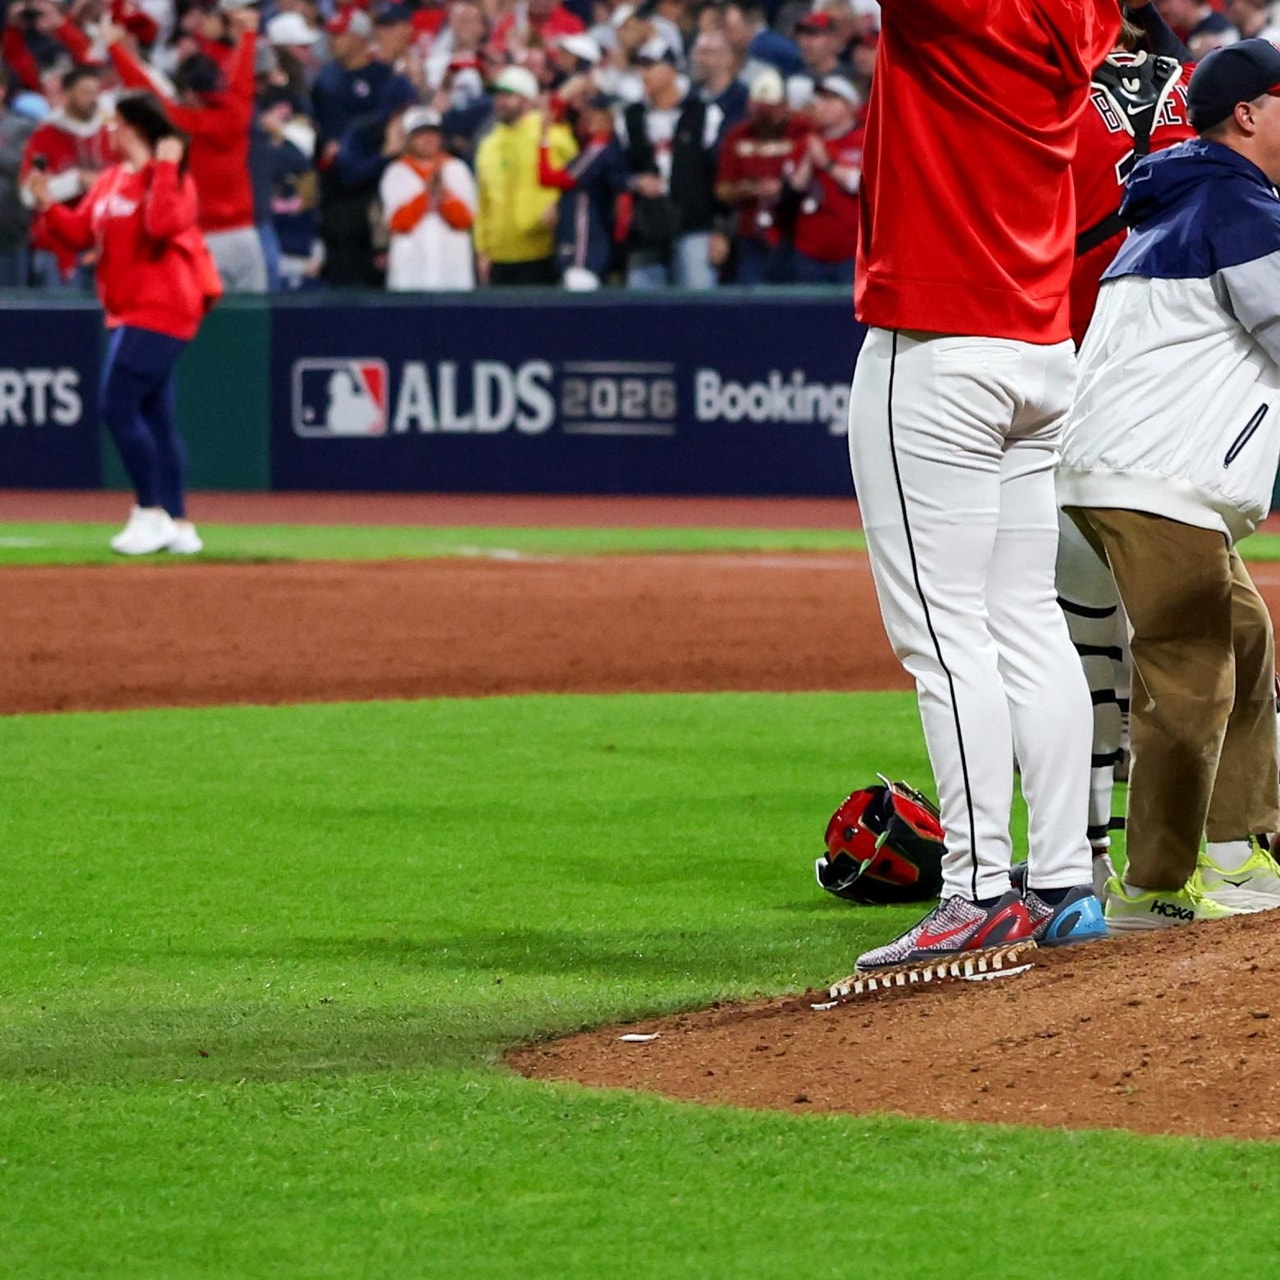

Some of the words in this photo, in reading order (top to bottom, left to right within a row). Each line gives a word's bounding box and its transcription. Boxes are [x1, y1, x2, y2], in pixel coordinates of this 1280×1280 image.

[0, 367, 83, 426] RTS
[393, 359, 555, 435] ALDS
[1149, 899, 1194, 922] HOKA
